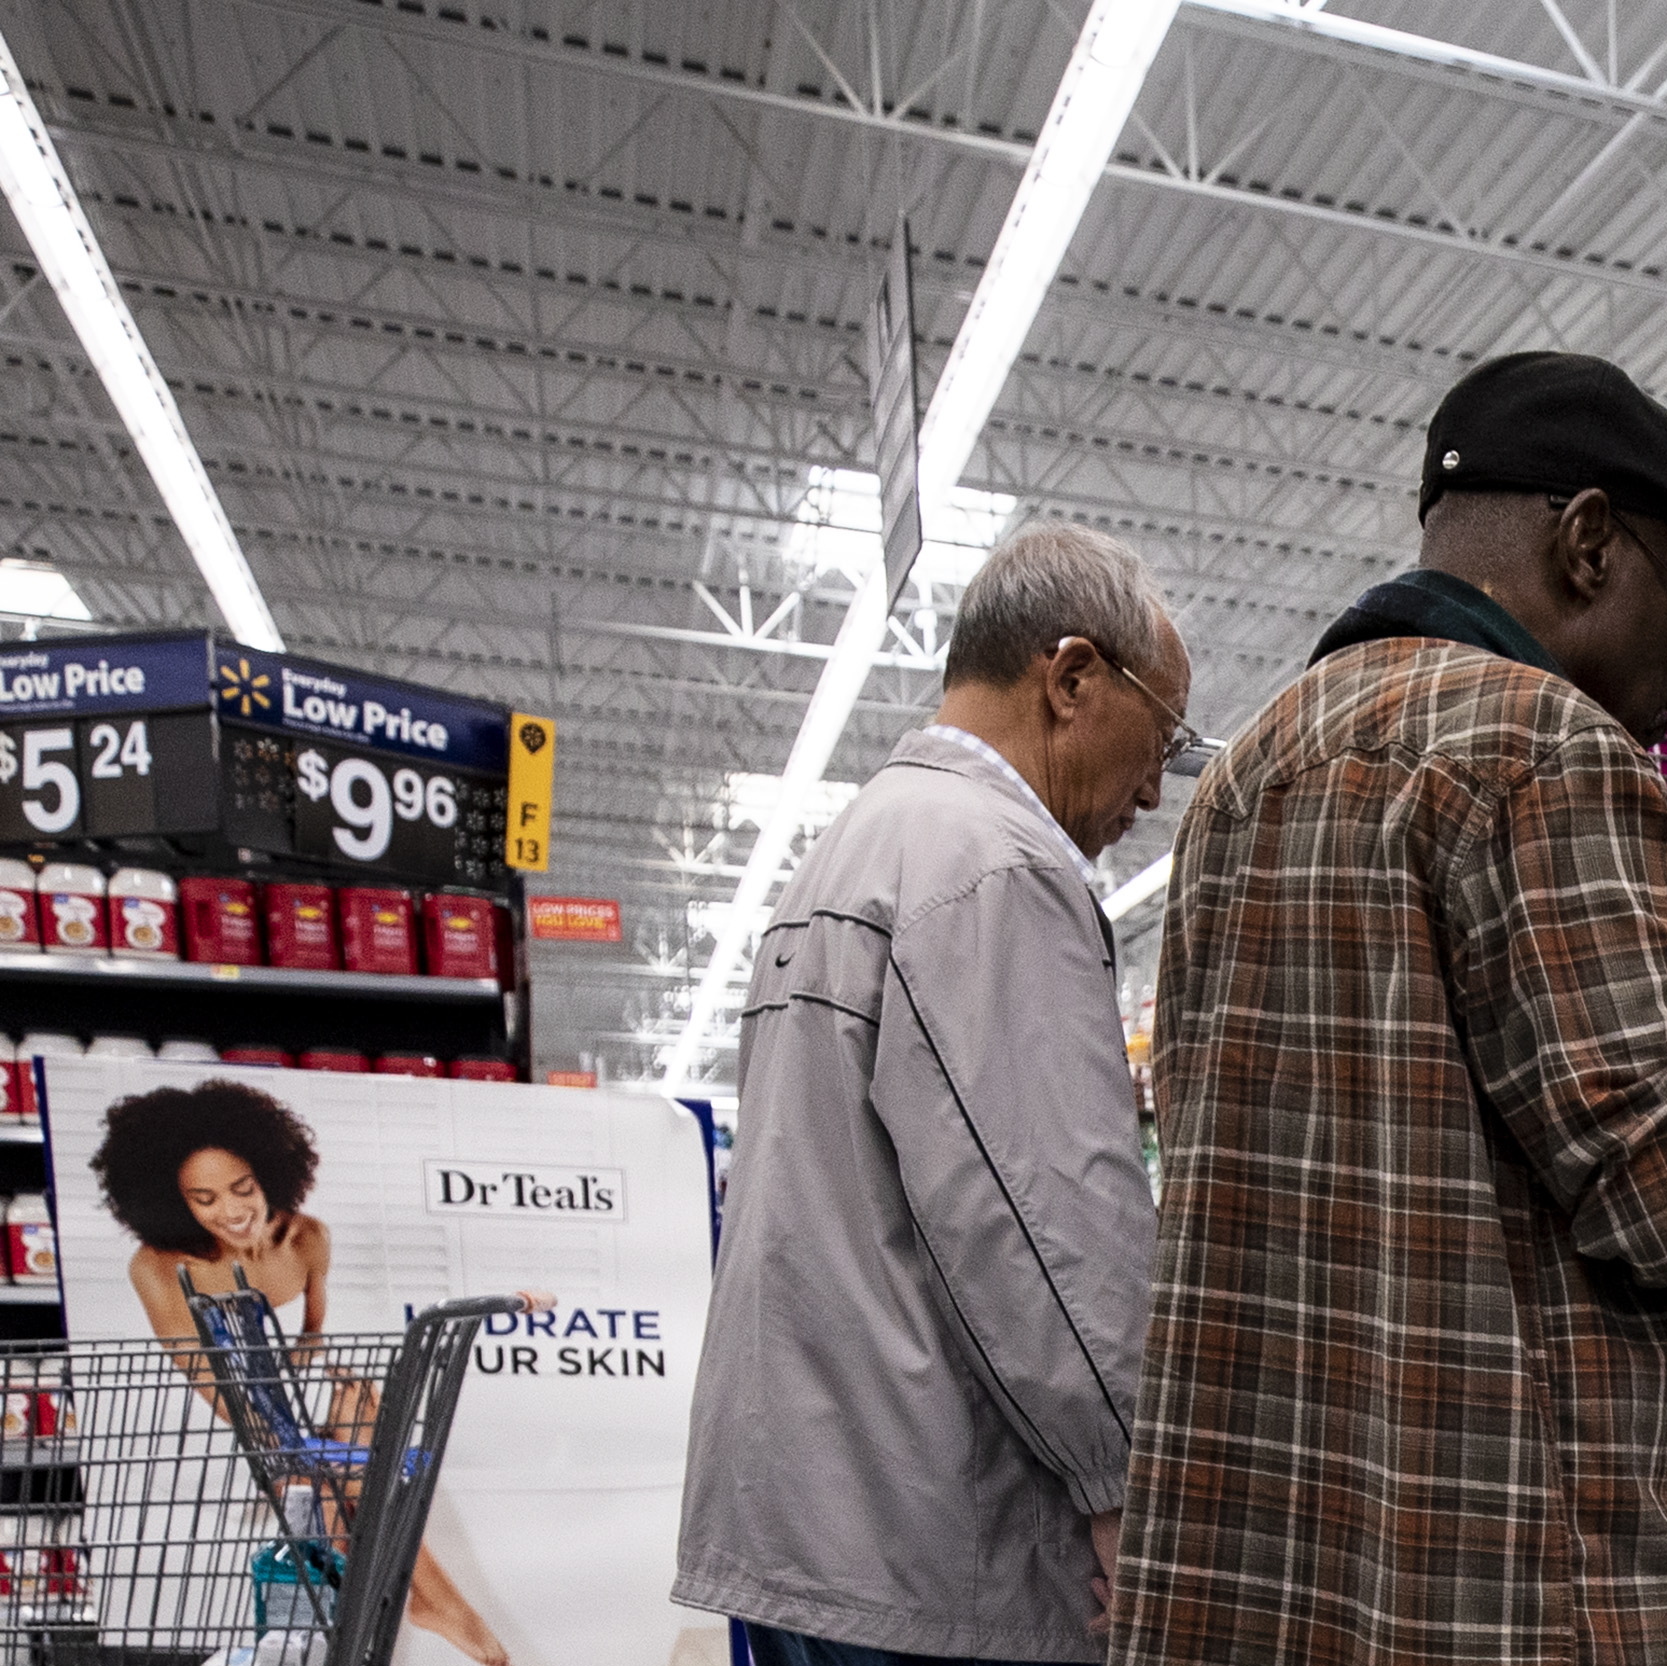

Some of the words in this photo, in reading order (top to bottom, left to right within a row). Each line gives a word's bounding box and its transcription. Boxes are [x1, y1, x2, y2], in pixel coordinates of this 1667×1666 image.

[0, 667, 60, 702] Low
[64, 659, 146, 698] Price
[281, 667, 347, 700] Everyday
[282, 684, 359, 730] Low
[362, 700, 449, 752] Price
[522, 802, 538, 827] F
[515, 837, 540, 863] 13
[436, 1169, 498, 1208] Dr
[501, 1171, 614, 1212] Teal's
[558, 1347, 666, 1379] SKIN
